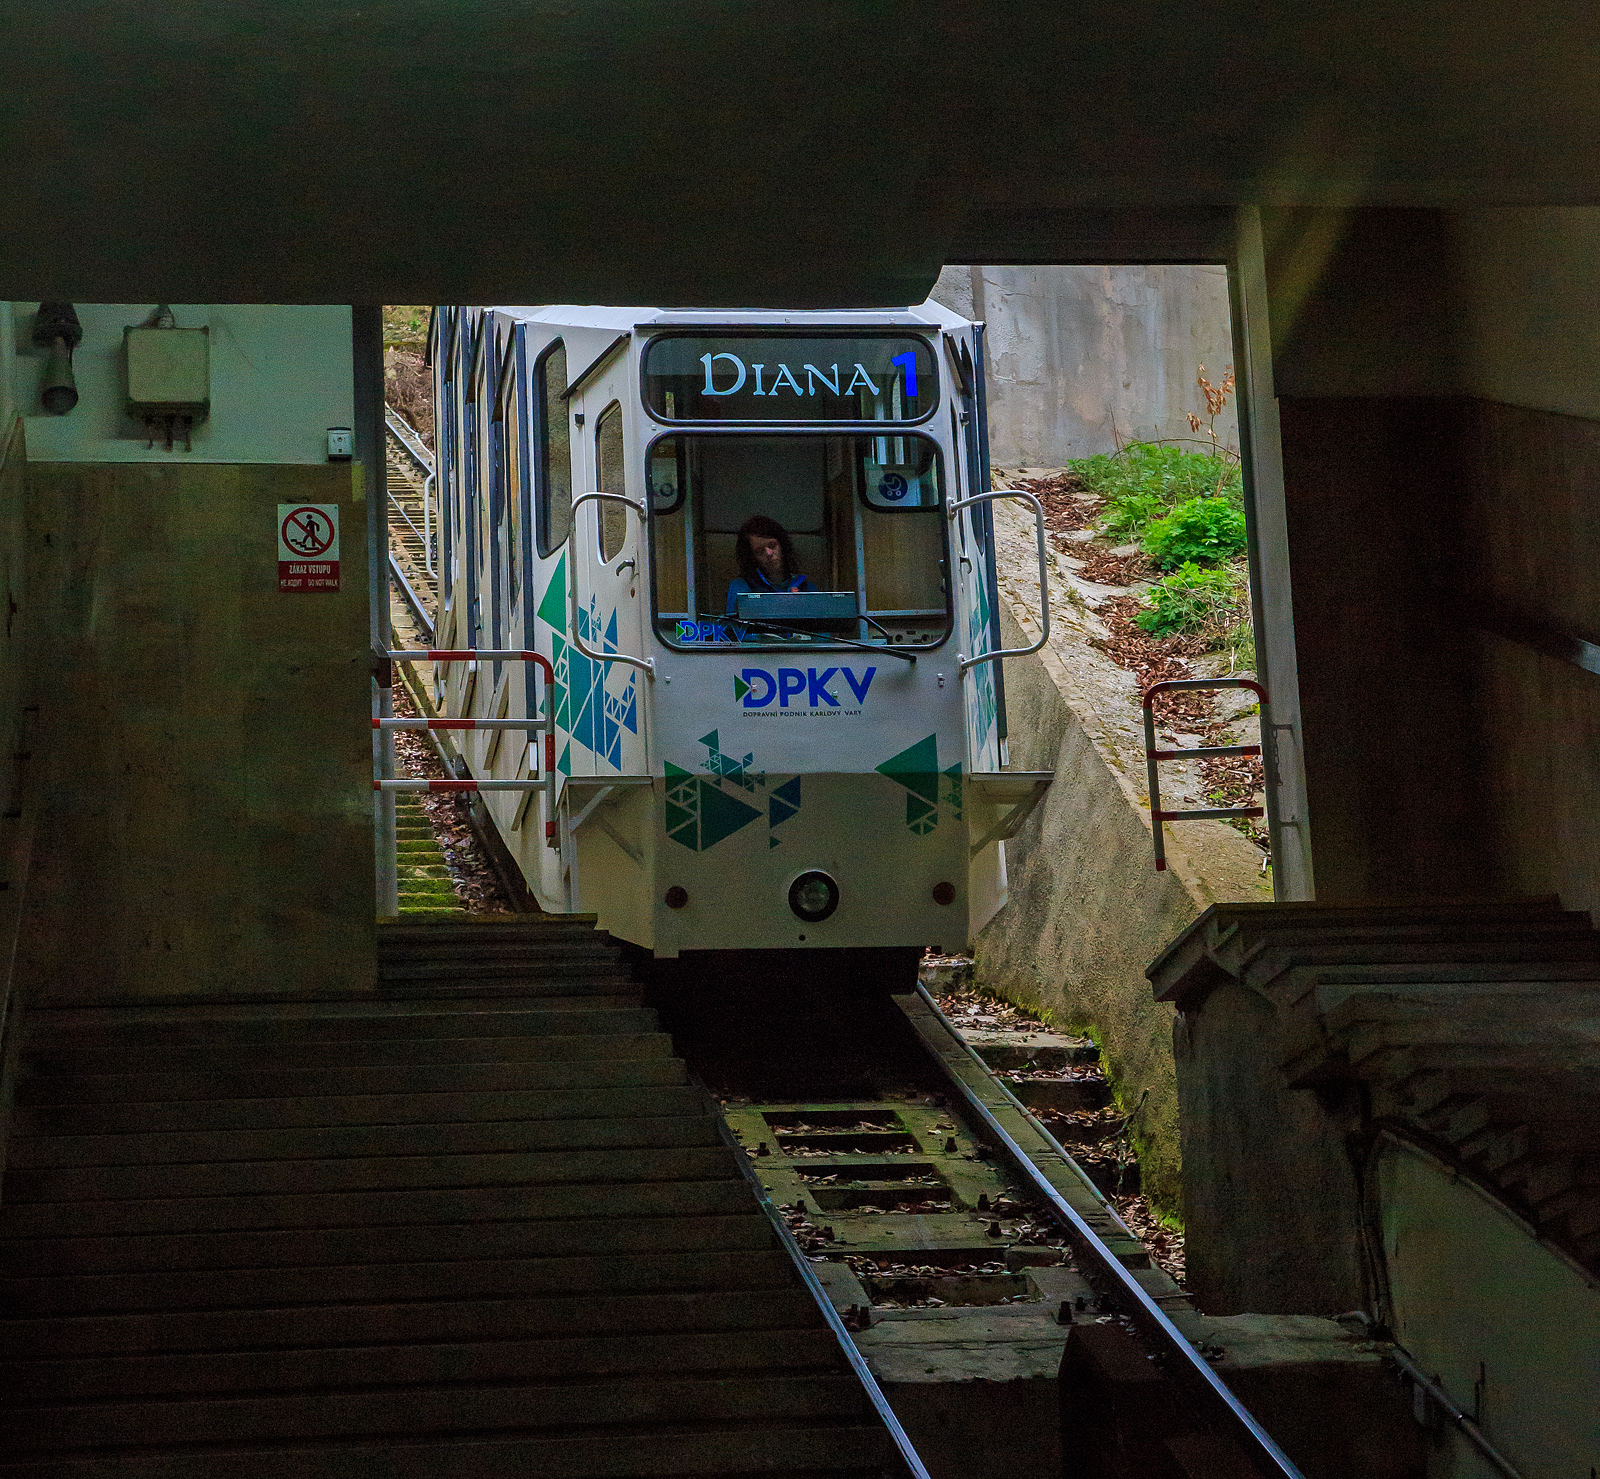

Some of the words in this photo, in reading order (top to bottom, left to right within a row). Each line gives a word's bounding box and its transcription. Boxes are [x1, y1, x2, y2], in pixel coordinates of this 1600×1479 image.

[700, 352, 880, 396] DIANA
[891, 351, 918, 397] 1
[289, 563, 307, 574] ZÁKAZ
[308, 564, 330, 574] VSTUPU
[680, 620, 748, 642] DPKV
[741, 666, 877, 709] DPKV
[742, 710, 778, 718] DOPRAVNÍ
